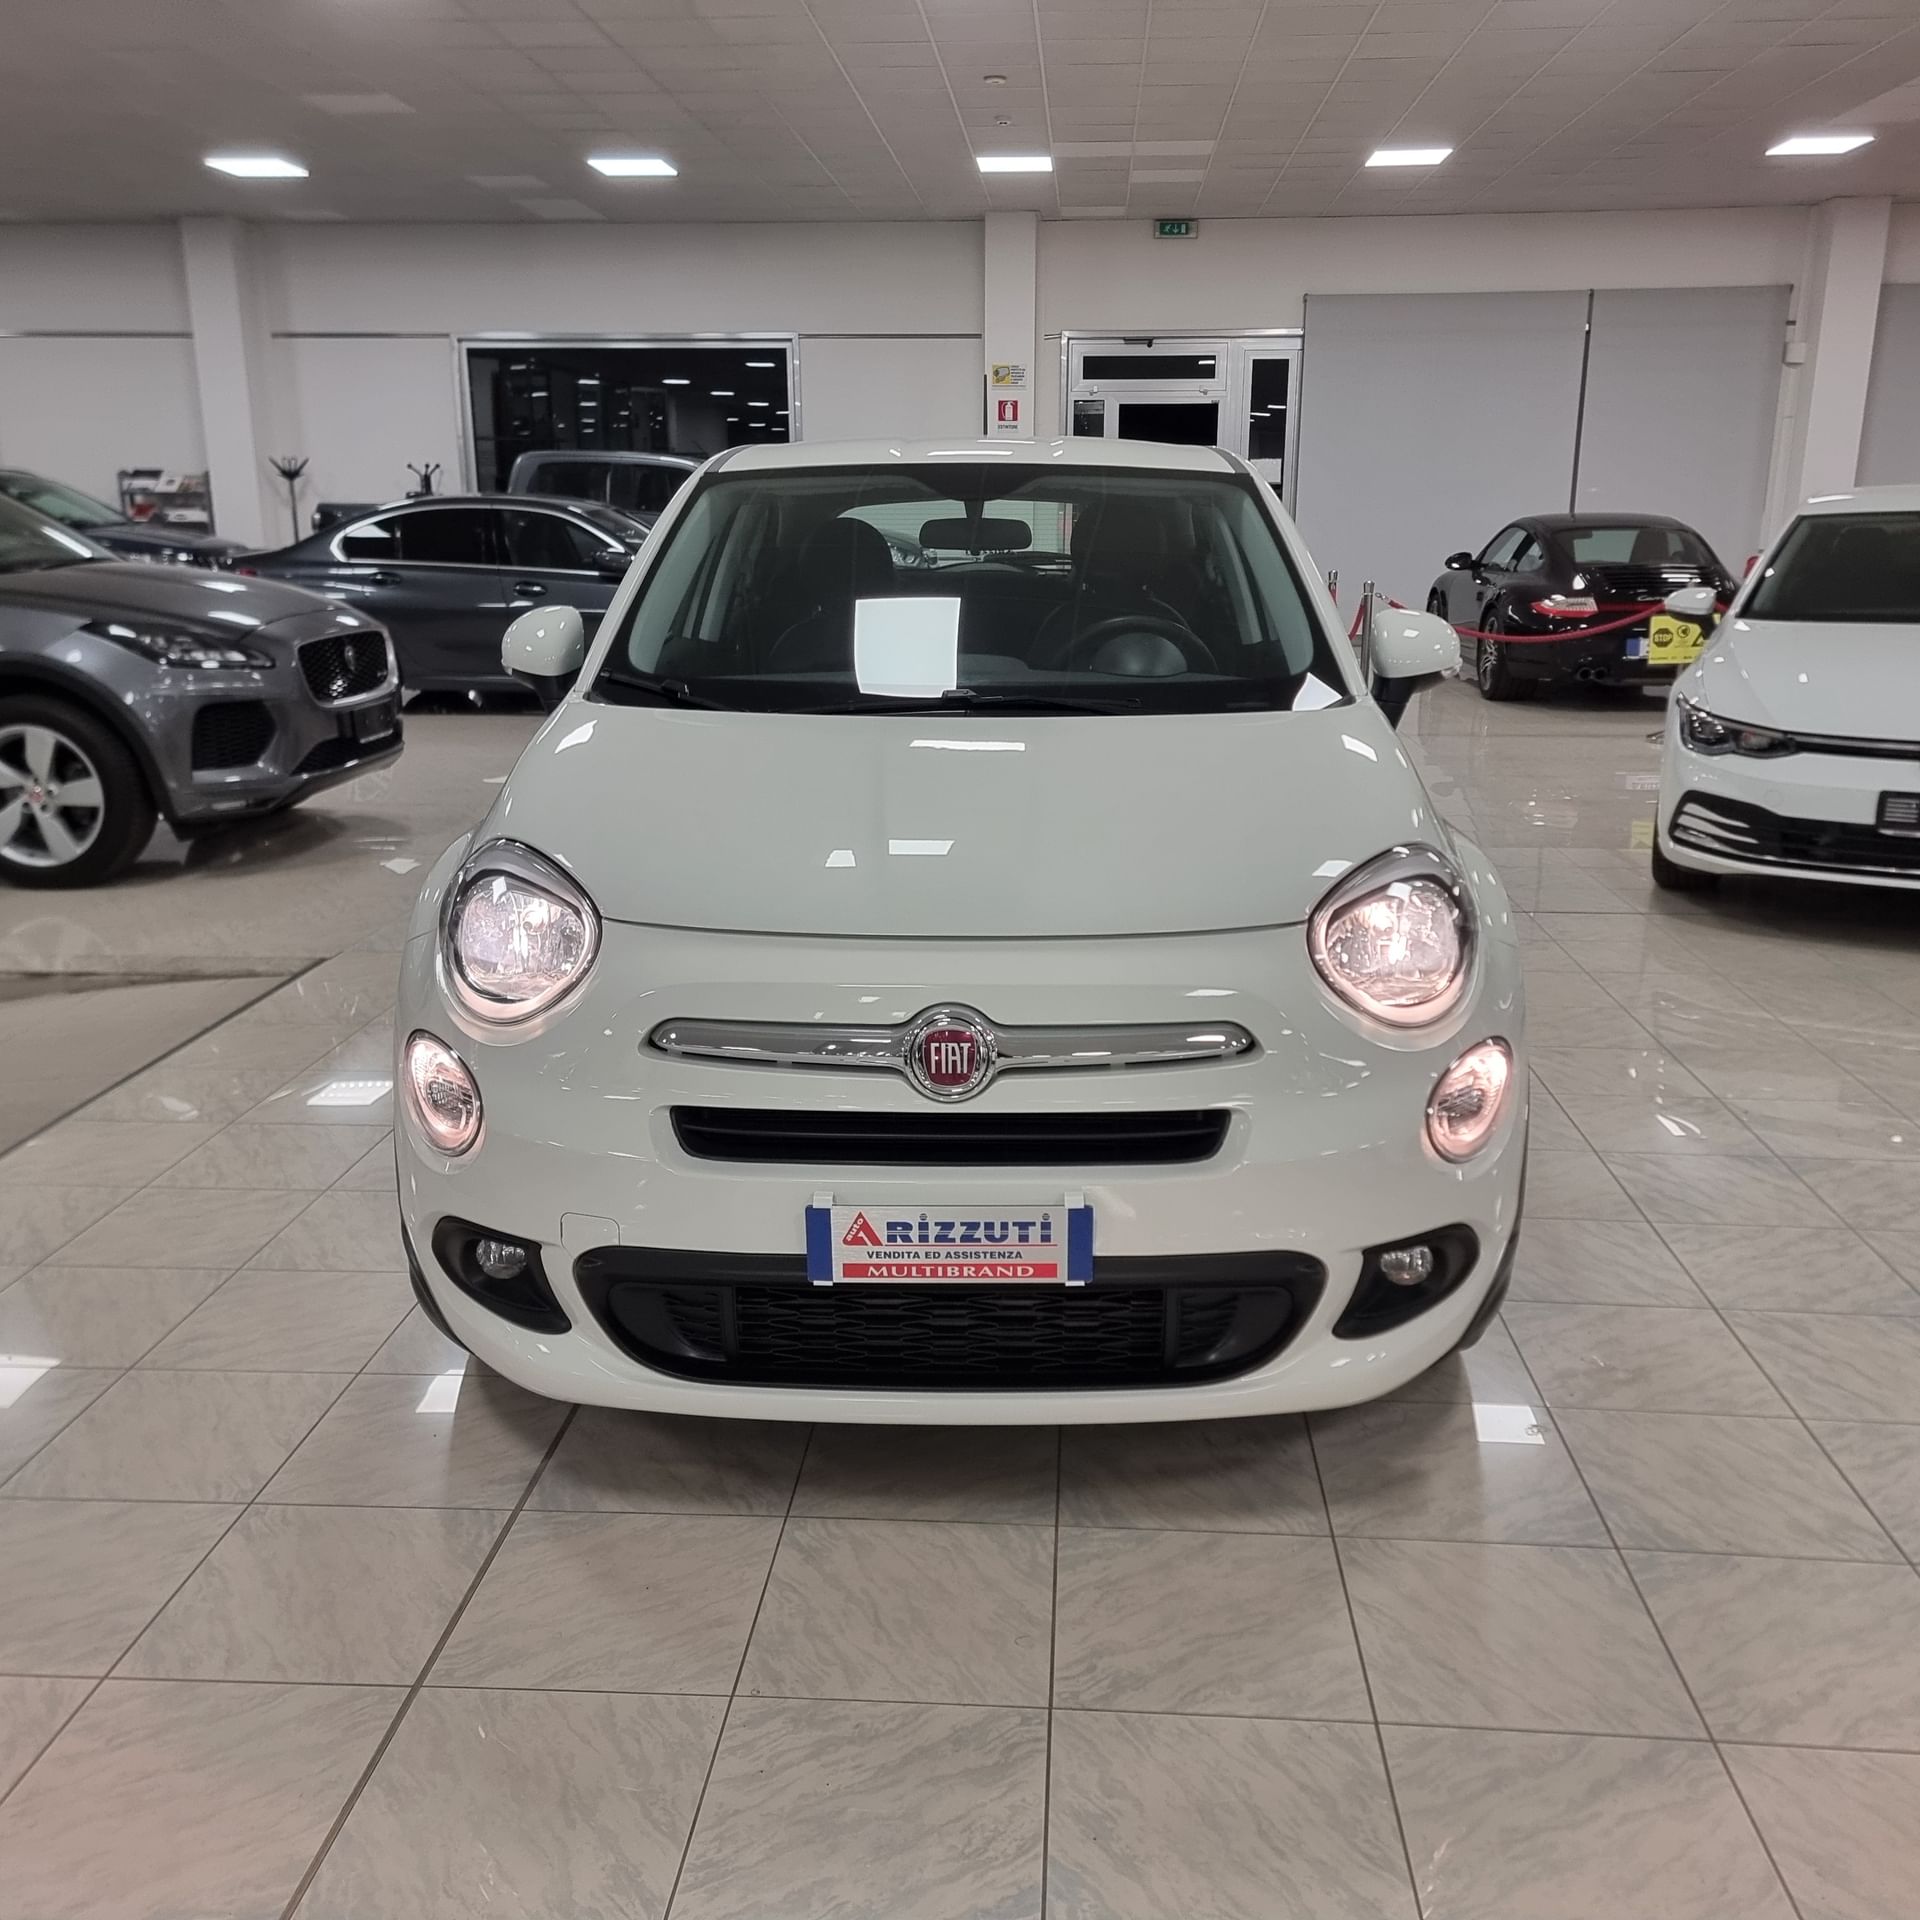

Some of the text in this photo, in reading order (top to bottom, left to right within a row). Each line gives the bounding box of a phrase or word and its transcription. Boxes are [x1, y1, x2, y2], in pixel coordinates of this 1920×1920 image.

[1654, 634, 1672, 642] STOP
[930, 1042, 972, 1075] FIAT
[846, 1218, 864, 1242] auto
[866, 1250, 1023, 1260] VENDITA ED ASSISTENZA
[866, 1264, 1035, 1278] MULTIBRAND
